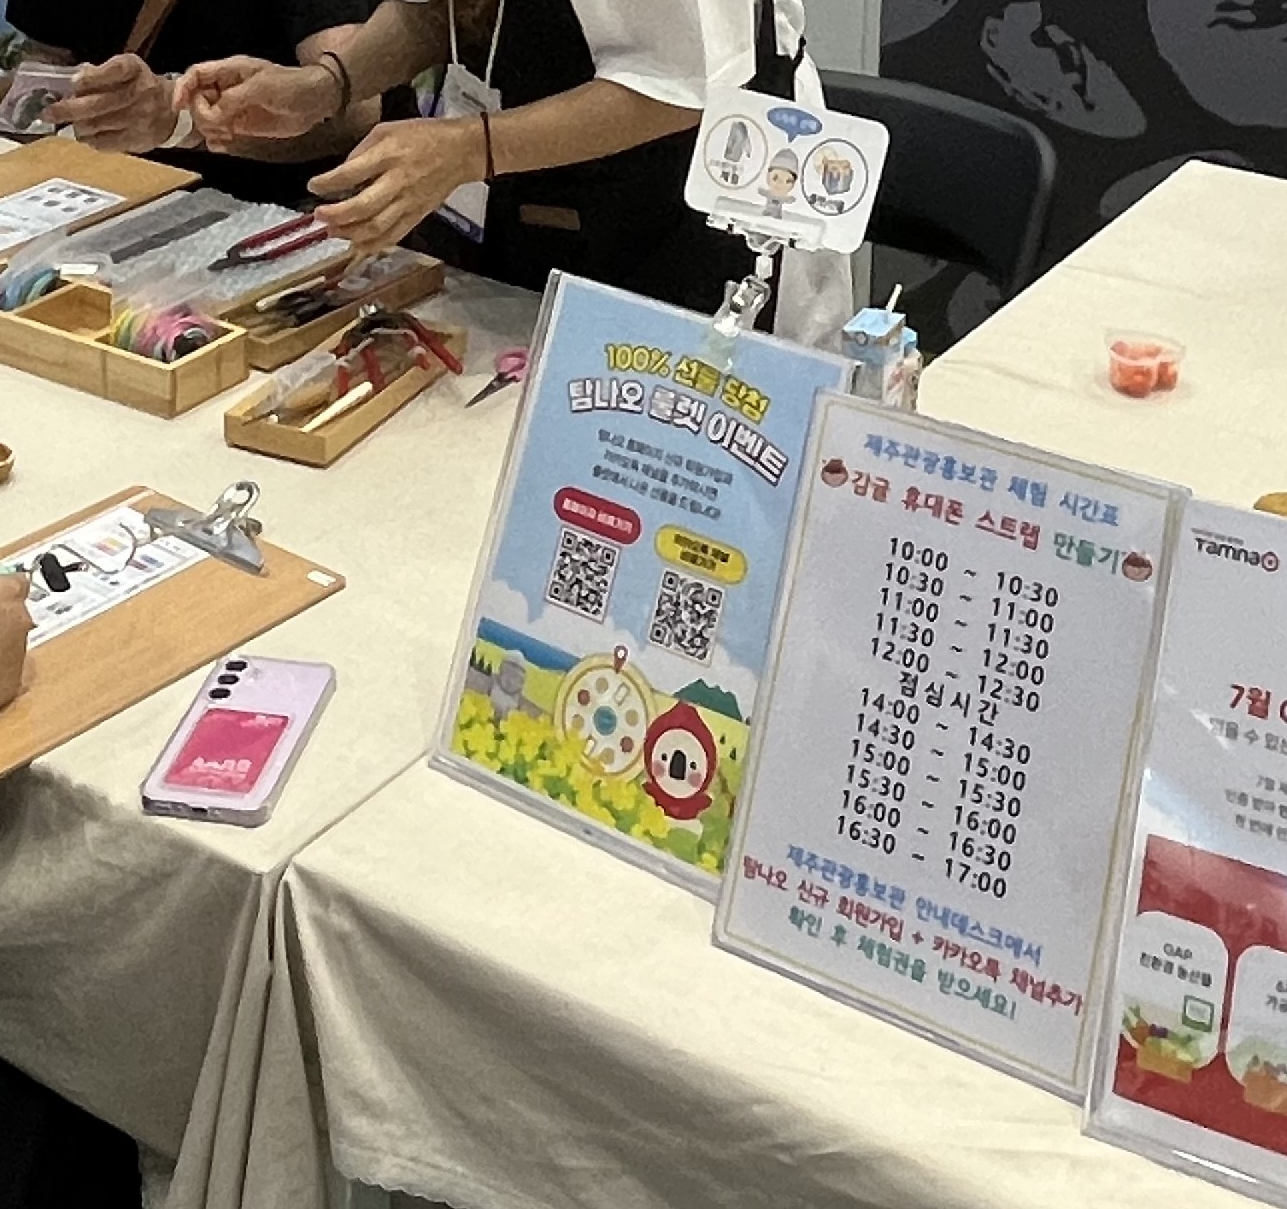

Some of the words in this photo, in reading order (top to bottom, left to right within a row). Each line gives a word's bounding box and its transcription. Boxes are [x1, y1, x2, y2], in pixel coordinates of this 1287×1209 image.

[605, 343, 670, 377] 100%
[568, 377, 645, 414] 탐나오
[707, 409, 790, 487] 이벤트
[864, 433, 998, 491] 제주관광홍보관
[1059, 492, 1119, 527] 시간표
[901, 486, 965, 526] 휴대폰
[975, 509, 1041, 551] 스트랩
[1053, 531, 1121, 574] 만들기
[885, 563, 944, 597] 10:30
[992, 598, 1054, 634] 11:00
[890, 537, 949, 571] 10:00
[997, 572, 1059, 608] 10:30
[876, 612, 934, 647] 11:30
[983, 649, 1045, 686] 12:00
[880, 587, 939, 622] 11:00
[987, 623, 1049, 660] 11:30
[871, 637, 929, 673] 12:00
[978, 674, 1040, 713] 12:30
[1229, 684, 1272, 720] 7월
[857, 713, 915, 750] 14:30
[964, 752, 1026, 791] 15:00
[862, 687, 920, 724] 14:00
[969, 726, 1031, 764] 14:30
[847, 764, 905, 802] 15:30
[954, 805, 1016, 845] 16:00
[852, 739, 910, 776] 15:00
[959, 779, 1021, 818] 15:30
[837, 815, 896, 854] 16:30
[945, 858, 1007, 898] 17:00
[842, 790, 901, 828] 16:00
[949, 831, 1011, 871] 16:30
[786, 844, 907, 911] 제주관광홍보관
[915, 896, 1043, 968] 안내데스크에서
[797, 879, 830, 909] 신규
[931, 936, 1002, 984] 카카오톡
